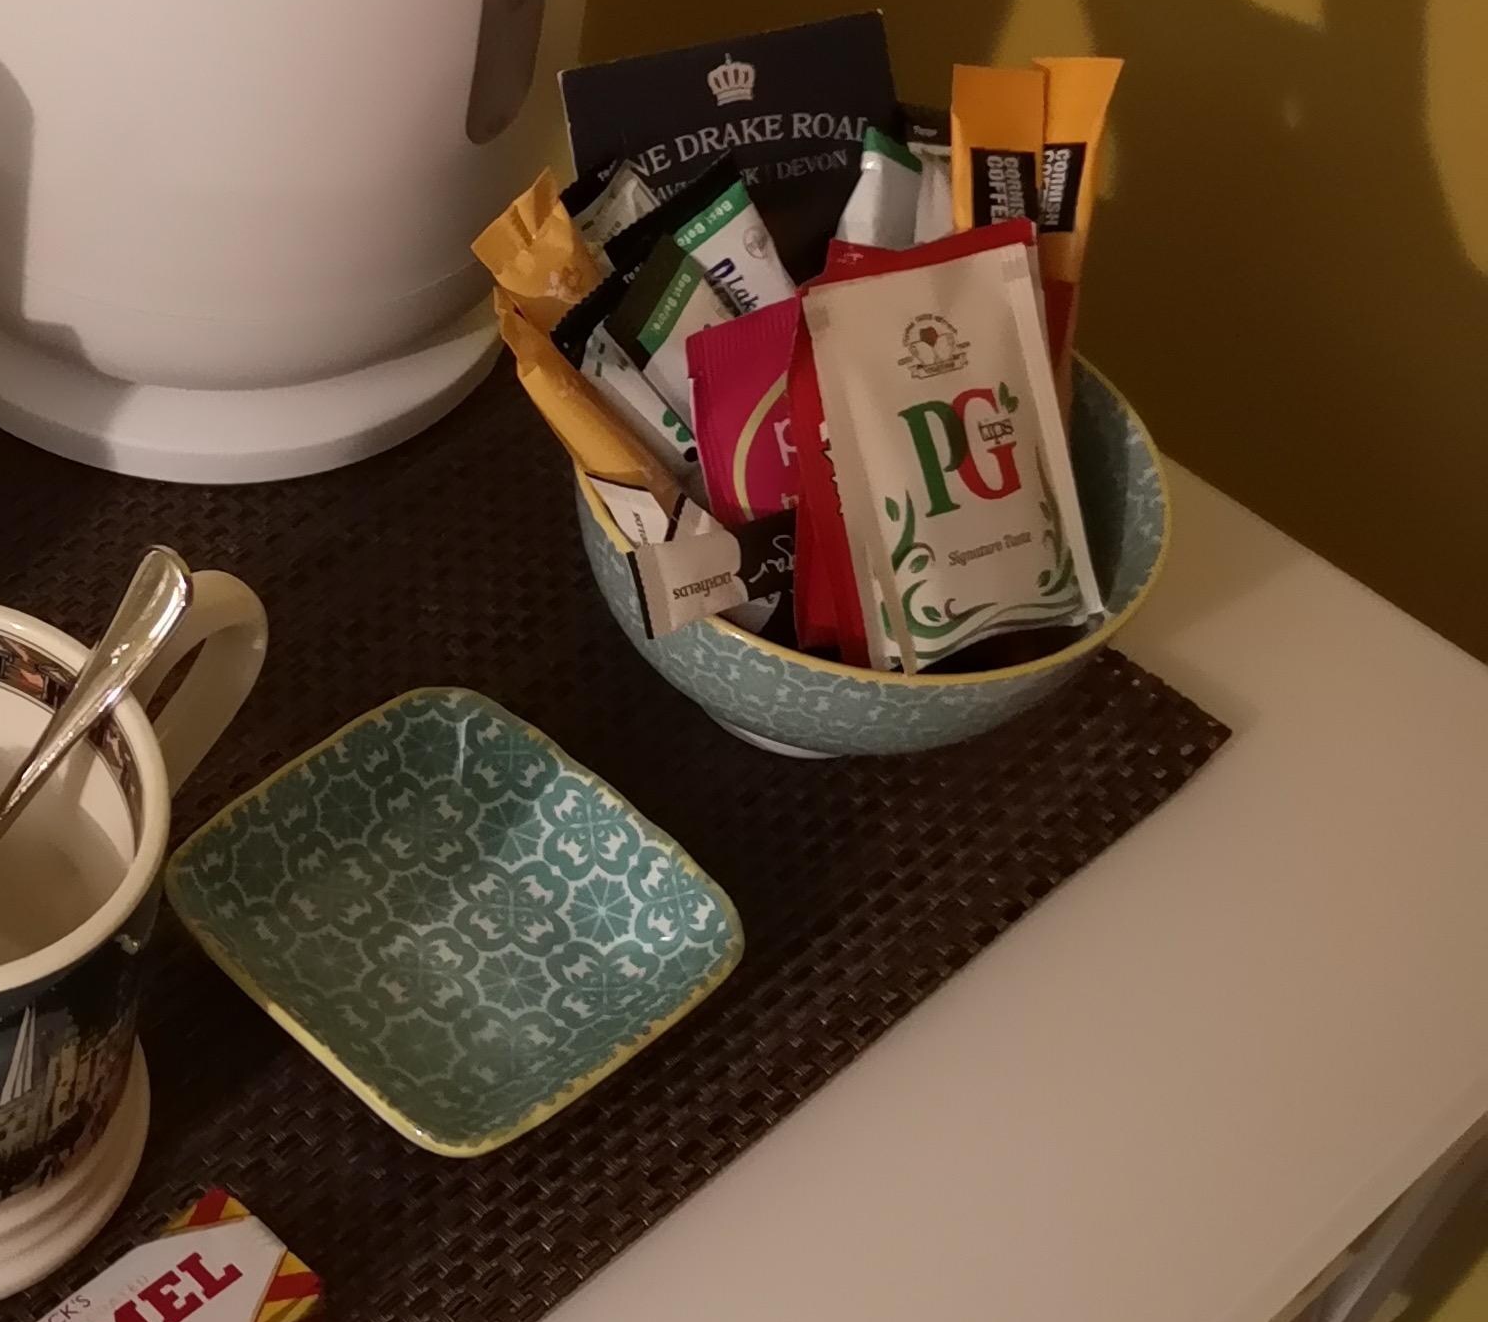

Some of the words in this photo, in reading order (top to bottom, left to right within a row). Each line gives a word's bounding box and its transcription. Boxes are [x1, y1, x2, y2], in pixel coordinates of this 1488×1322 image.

[629, 144, 672, 178] NE
[675, 114, 784, 162] DRAKE
[776, 149, 849, 180] DEVON
[986, 155, 1010, 225] COFFE
[1004, 156, 1026, 219] CORNIS
[1044, 148, 1071, 226] CORNISH
[897, 387, 1022, 518] PG
